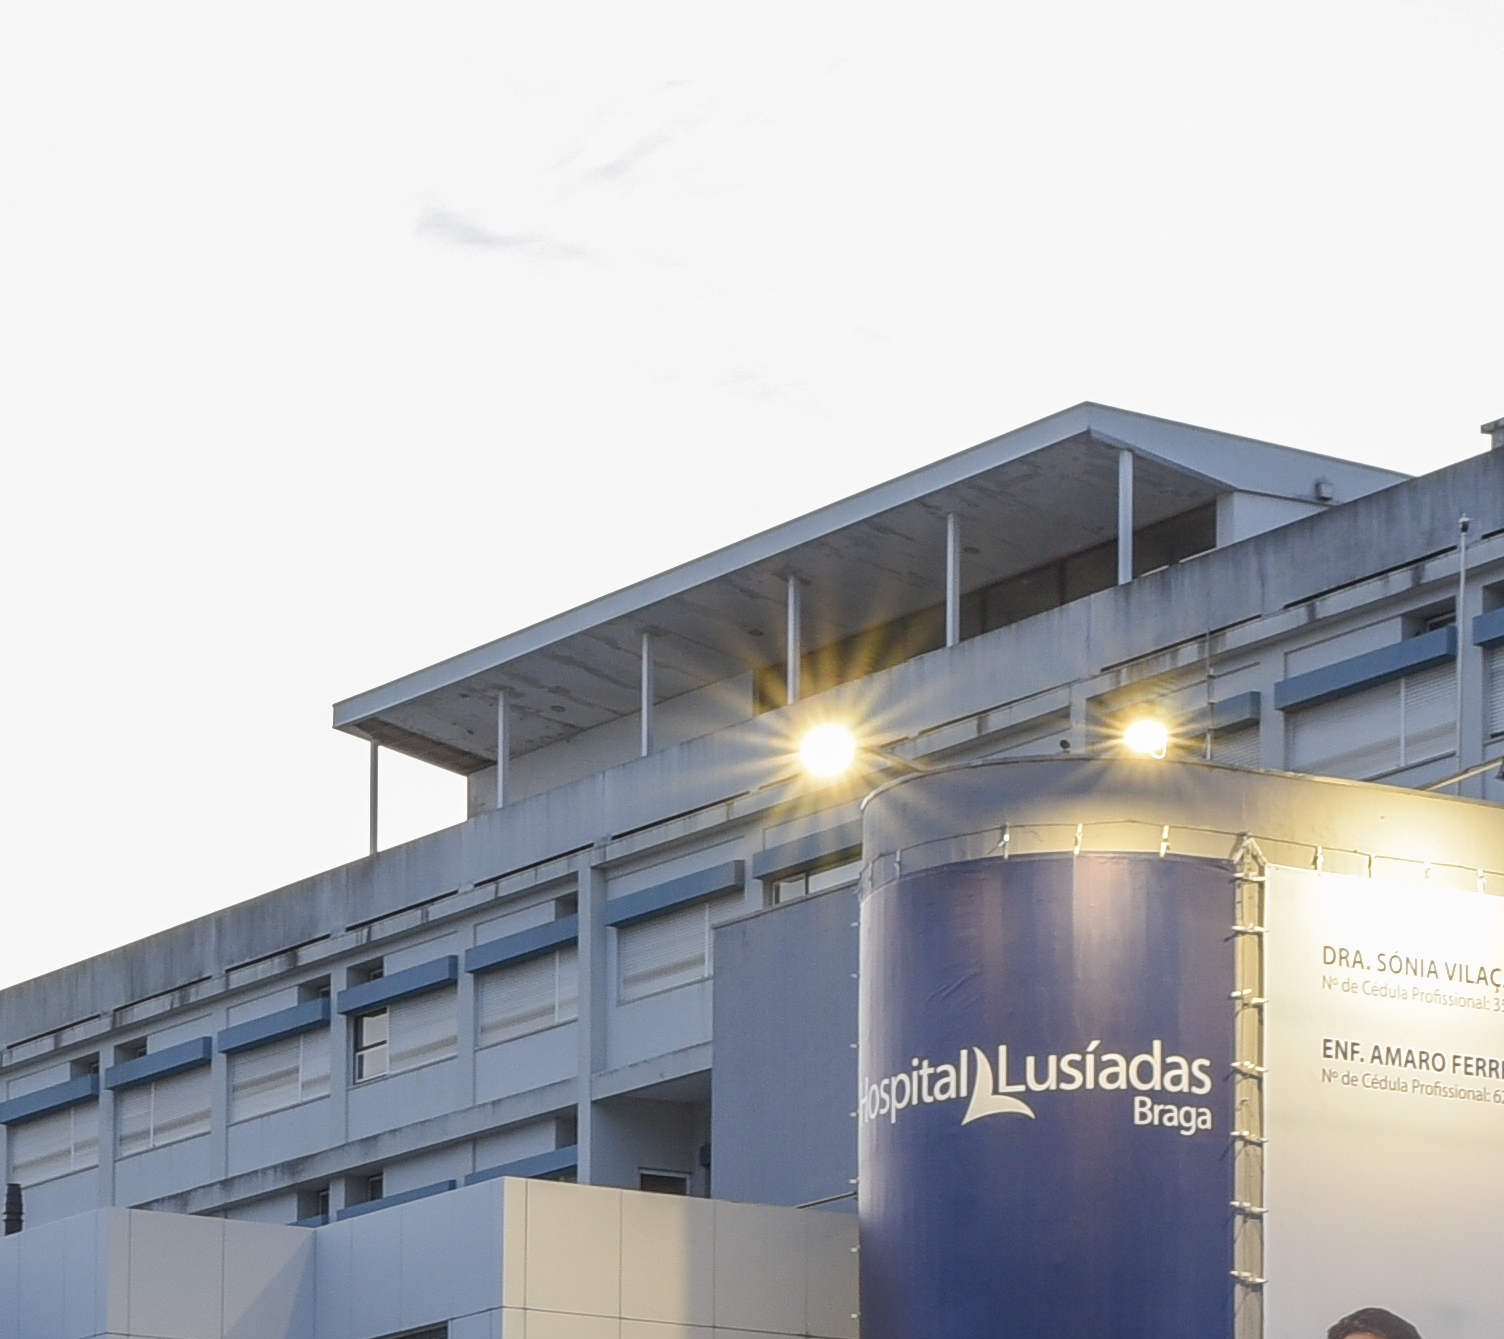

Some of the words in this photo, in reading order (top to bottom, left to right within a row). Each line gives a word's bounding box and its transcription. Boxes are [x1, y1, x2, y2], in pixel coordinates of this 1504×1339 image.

[1322, 945, 1371, 971] DRA.
[1376, 950, 1440, 980] SÓNIA
[1341, 977, 1359, 994] de
[1361, 980, 1408, 1000] Cédula
[1322, 1038, 1365, 1064] ENF.
[1369, 1044, 1447, 1073] AMARO
[858, 1048, 969, 1124] Hospital
[997, 1039, 1213, 1095] Lusíadas
[1341, 1070, 1359, 1087] de
[1361, 1072, 1408, 1093] Cédula
[1411, 1078, 1491, 1102] Profissional:
[1133, 1095, 1213, 1136] Braga
